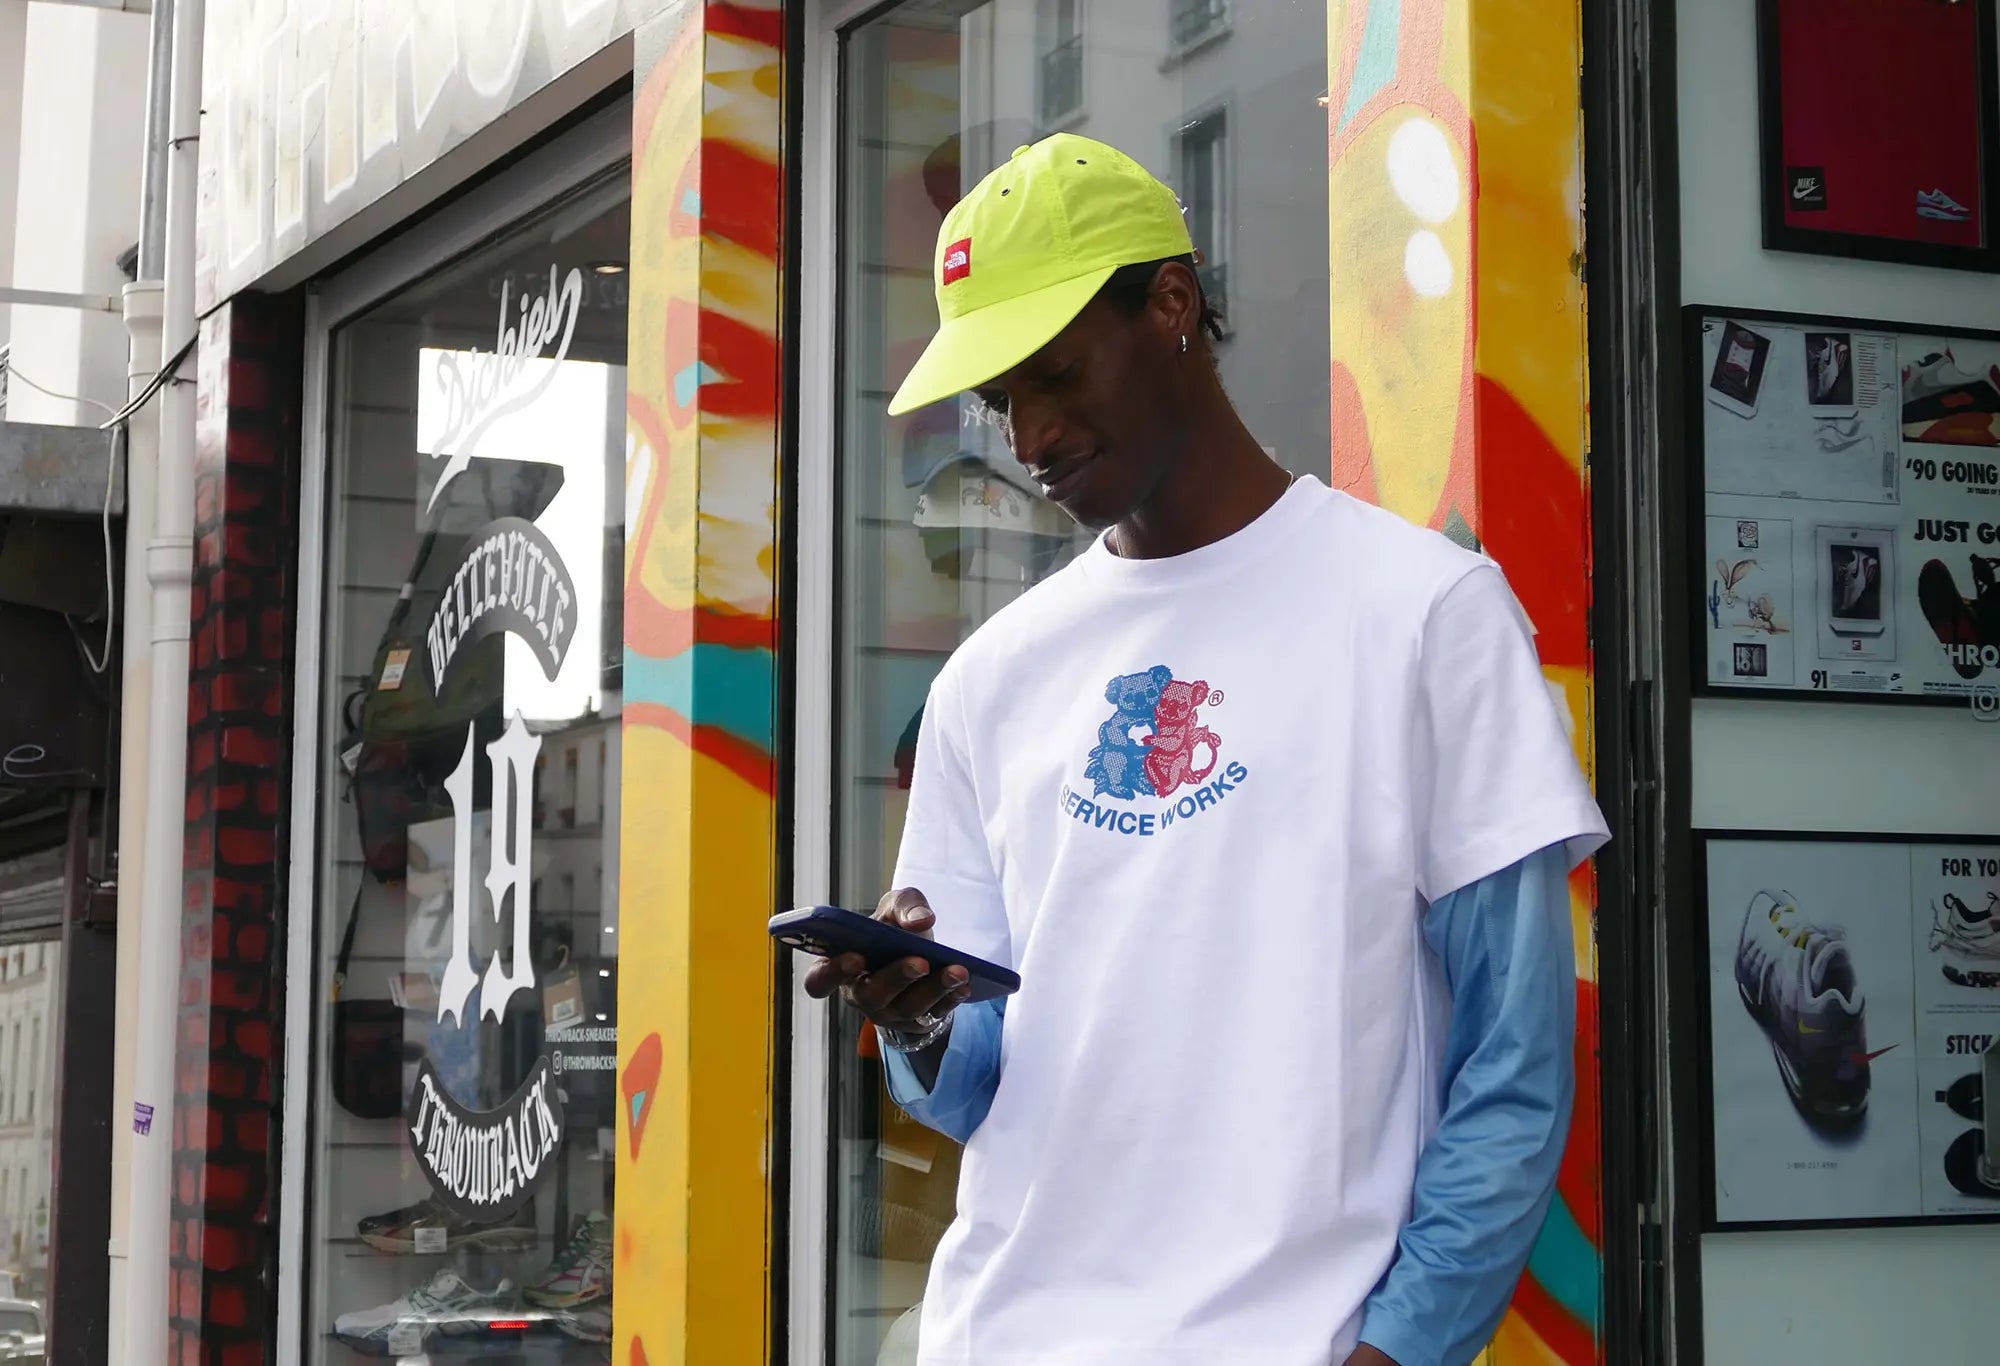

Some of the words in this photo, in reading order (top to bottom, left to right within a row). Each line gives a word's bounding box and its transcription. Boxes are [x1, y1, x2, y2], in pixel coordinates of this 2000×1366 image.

[1797, 177, 1816, 189] NIKE
[427, 263, 582, 514] Dickies
[1942, 461, 1998, 485] GOING
[1914, 518, 1970, 543] JUST
[1977, 522, 2000, 545] G
[1811, 670, 1828, 689] 91
[1059, 784, 1155, 836] SERVICE
[1161, 761, 1248, 830] WORKS
[1941, 858, 1972, 876] FOR
[1977, 858, 2000, 877] YO
